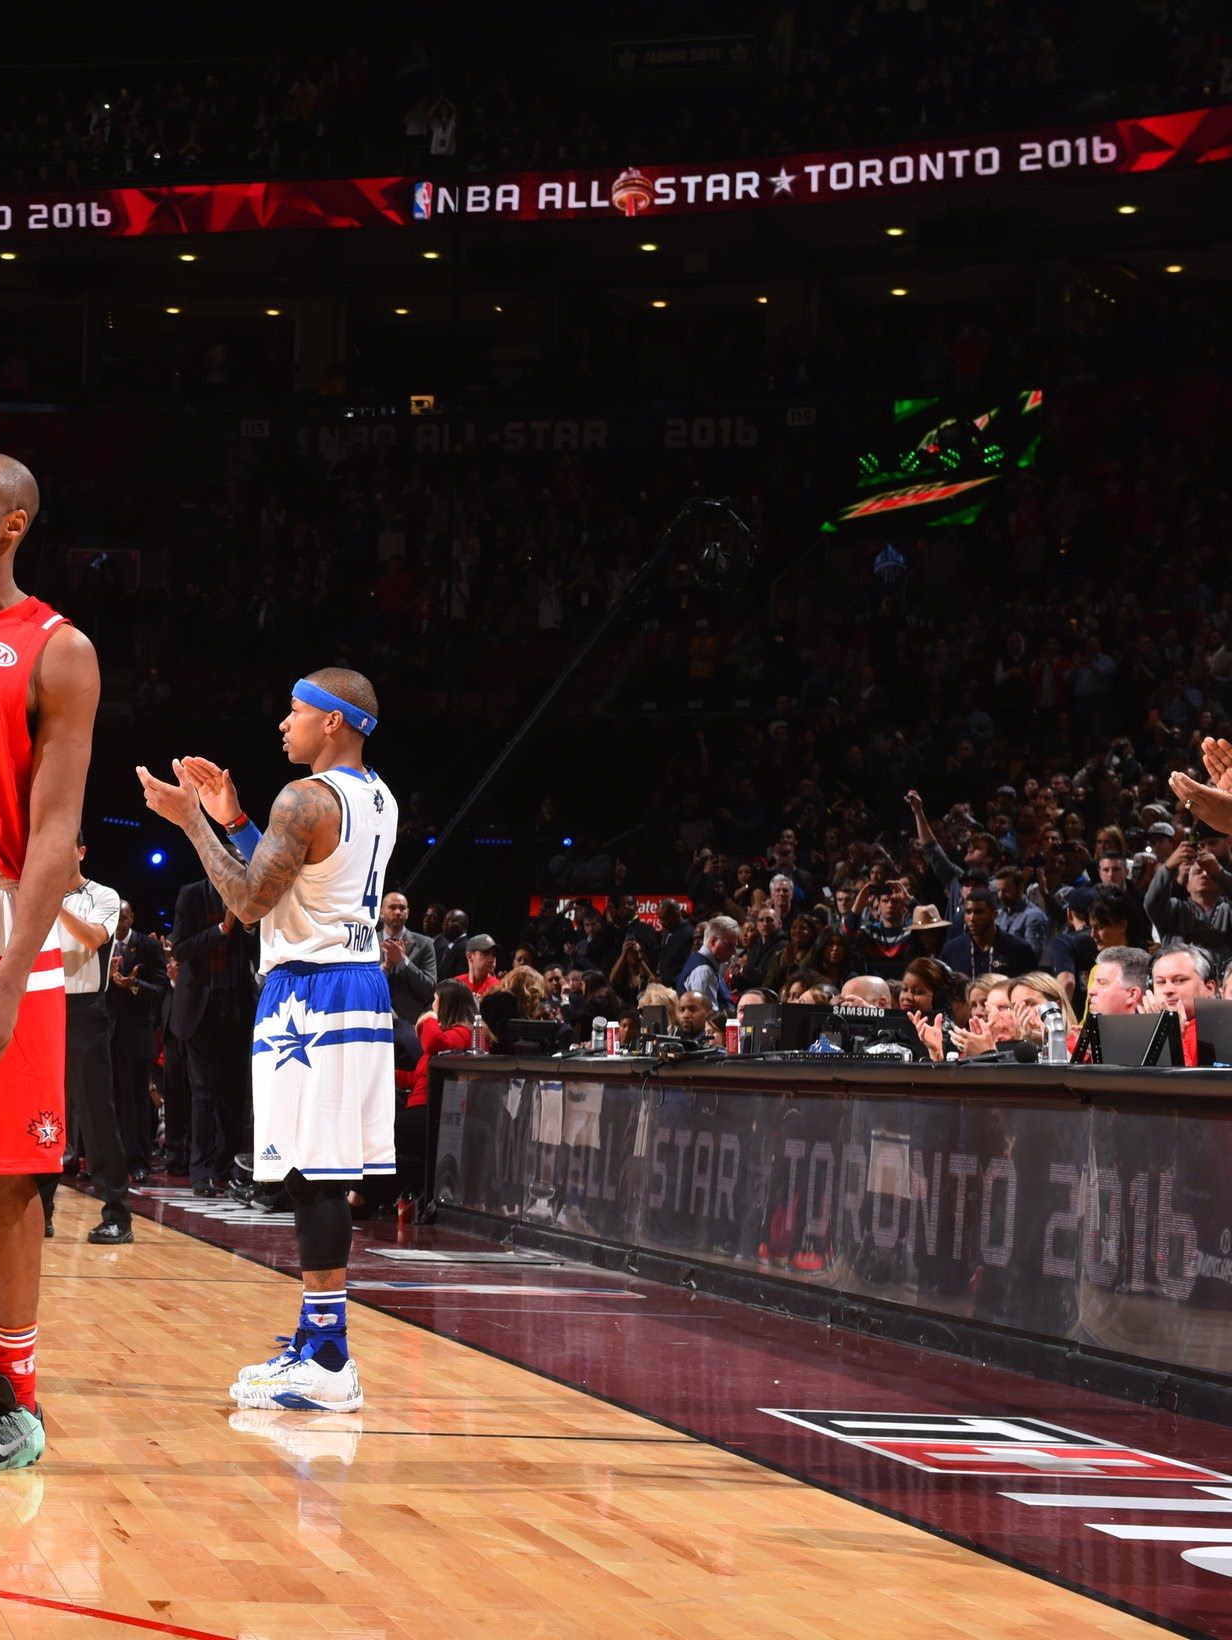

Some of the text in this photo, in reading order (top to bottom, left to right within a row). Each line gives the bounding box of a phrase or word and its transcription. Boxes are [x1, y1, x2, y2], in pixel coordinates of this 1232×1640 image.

[437, 135, 1117, 213] NBA ALL STAR TORONTO 2016
[28, 202, 112, 229] 2016
[664, 416, 759, 448] 2016
[362, 834, 381, 920] 4
[832, 1005, 885, 1018] SAMSUNG
[260, 1153, 282, 1161] adidas
[648, 1127, 740, 1222] STAR
[784, 1139, 1017, 1268] TORONTO
[1042, 1162, 1198, 1301] 2016
